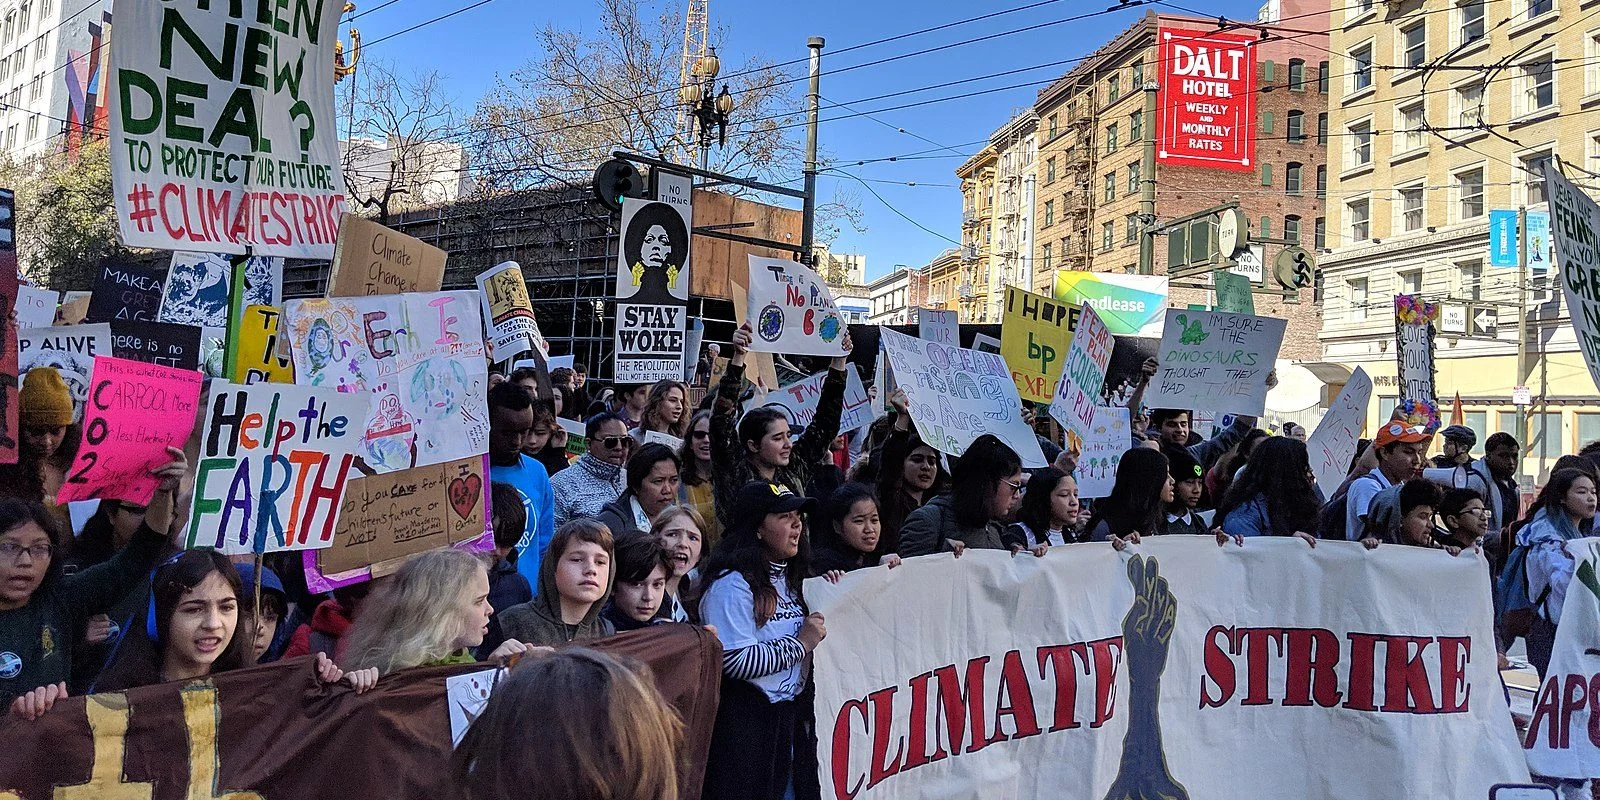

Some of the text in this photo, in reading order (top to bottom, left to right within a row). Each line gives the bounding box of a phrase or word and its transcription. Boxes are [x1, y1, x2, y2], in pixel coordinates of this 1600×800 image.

[159, 8, 306, 101] NEW
[1172, 44, 1245, 80] DALT
[1183, 80, 1232, 98] HOTEL
[1186, 102, 1228, 115] WEEKLY
[1182, 123, 1231, 137] MONTHLY
[1189, 138, 1223, 150] RATES
[124, 138, 335, 191] TO PROTECT OUR FUTURE
[669, 185, 680, 195] NO
[372, 233, 412, 266] Climate
[1240, 255, 1252, 263] NO
[369, 261, 406, 293] Change
[1009, 289, 1015, 312] I
[496, 320, 513, 332] STOP
[503, 323, 528, 334] FOSSIL
[624, 306, 678, 329] STAY
[803, 308, 815, 335] B
[1228, 315, 1263, 332] SURE
[498, 335, 515, 347] SAVE
[619, 330, 682, 352] WOKE
[1220, 328, 1247, 345] THE
[1404, 325, 1425, 345] LOVE
[40, 336, 96, 358] ALIVE
[169, 345, 183, 354] no
[1028, 332, 1056, 374] bp
[616, 361, 680, 371] THE REVOLUTION
[926, 342, 1008, 379] OCEAN
[1404, 349, 1427, 372] YOUR
[1163, 367, 1259, 379] THOUGHT THEY
[1160, 381, 1185, 395] HAD
[1073, 390, 1096, 430] PLAN
[206, 391, 348, 463] Help the
[1199, 624, 1471, 714] STRIKE
[831, 636, 1123, 800] CLIMATE
